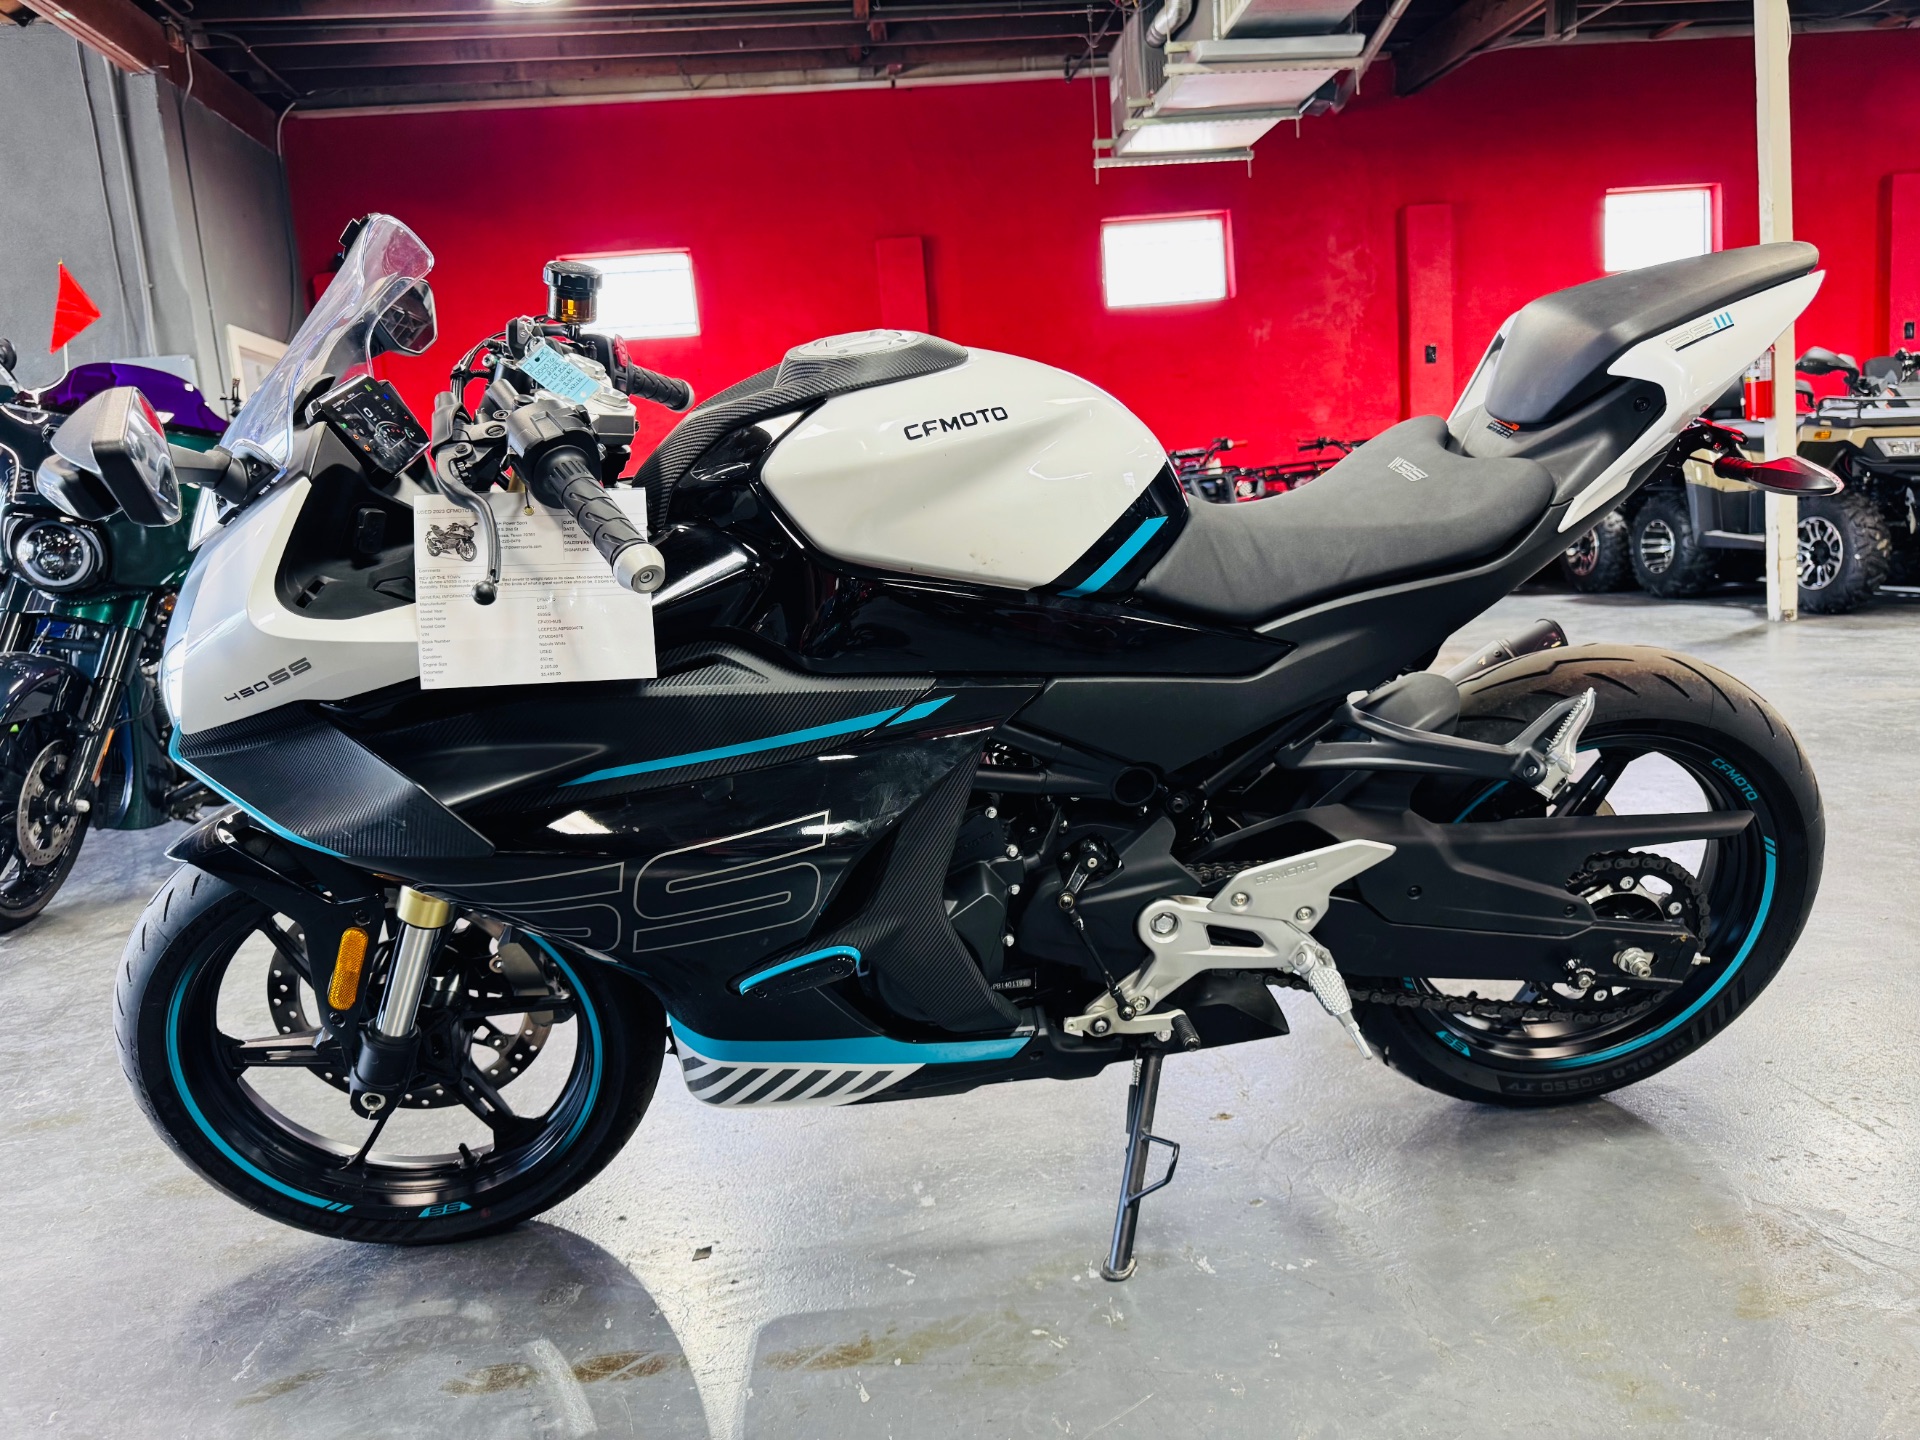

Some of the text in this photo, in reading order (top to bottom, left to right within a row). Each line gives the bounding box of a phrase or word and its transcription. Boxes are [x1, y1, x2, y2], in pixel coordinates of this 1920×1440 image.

[903, 406, 1009, 441] CFMOTO
[223, 656, 312, 702] 450SS
[1711, 758, 1758, 800] CFMOTO
[1541, 1073, 1608, 1093] ROSSO
